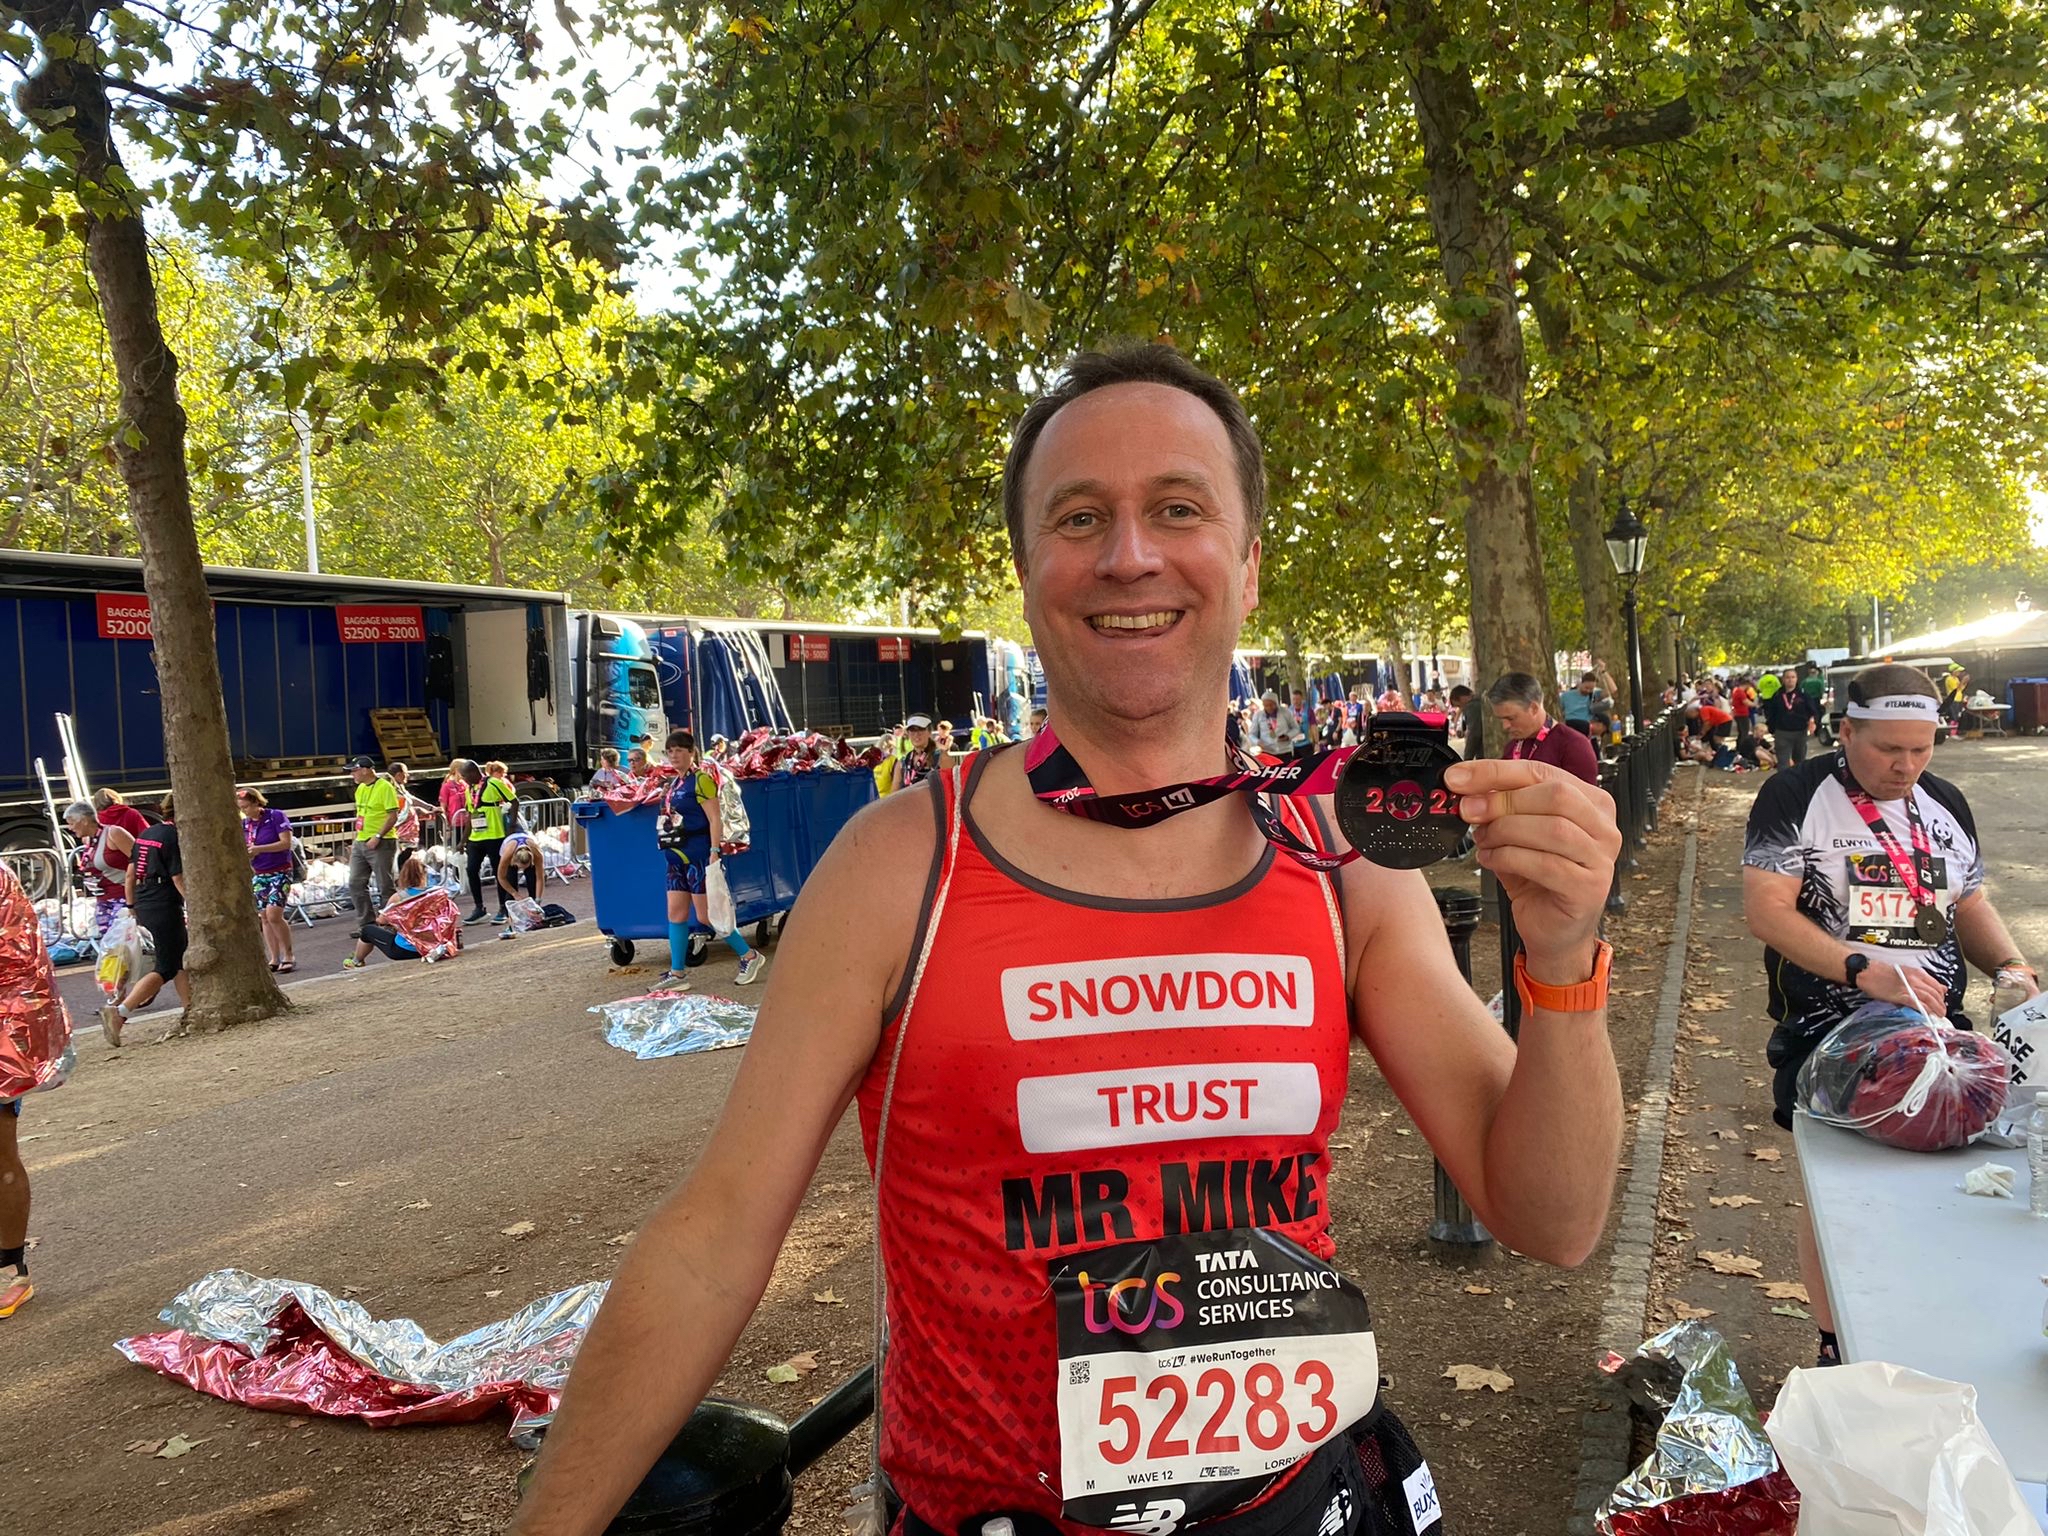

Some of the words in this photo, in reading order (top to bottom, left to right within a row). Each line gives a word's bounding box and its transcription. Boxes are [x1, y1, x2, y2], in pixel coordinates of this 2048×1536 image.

[107, 607, 151, 618] BAGGAG
[344, 616, 380, 625] BAGGAGE
[381, 616, 416, 625] NUMBERS
[344, 627, 380, 639] 52500
[388, 627, 420, 639] 52001
[1833, 838, 1873, 849] ELWYN
[1890, 937, 1908, 948] new
[1027, 970, 1297, 1022] SNOWDON
[1097, 1079, 1259, 1128] TRUST
[1001, 1168, 1136, 1251] MR
[1160, 1152, 1322, 1236] MIKE
[1195, 1250, 1259, 1274] TATA
[1197, 1271, 1342, 1300] CONSULTANCY
[1078, 1271, 1185, 1335] tcs
[1199, 1298, 1295, 1326] SERVICES
[1190, 1347, 1276, 1364] #WeRunTogether
[1097, 1359, 1338, 1466] 52283
[1264, 1454, 1299, 1470] LORRY
[1086, 1480, 1096, 1490] M
[1127, 1472, 1159, 1485] WAVE
[1162, 1470, 1174, 1482] 12
